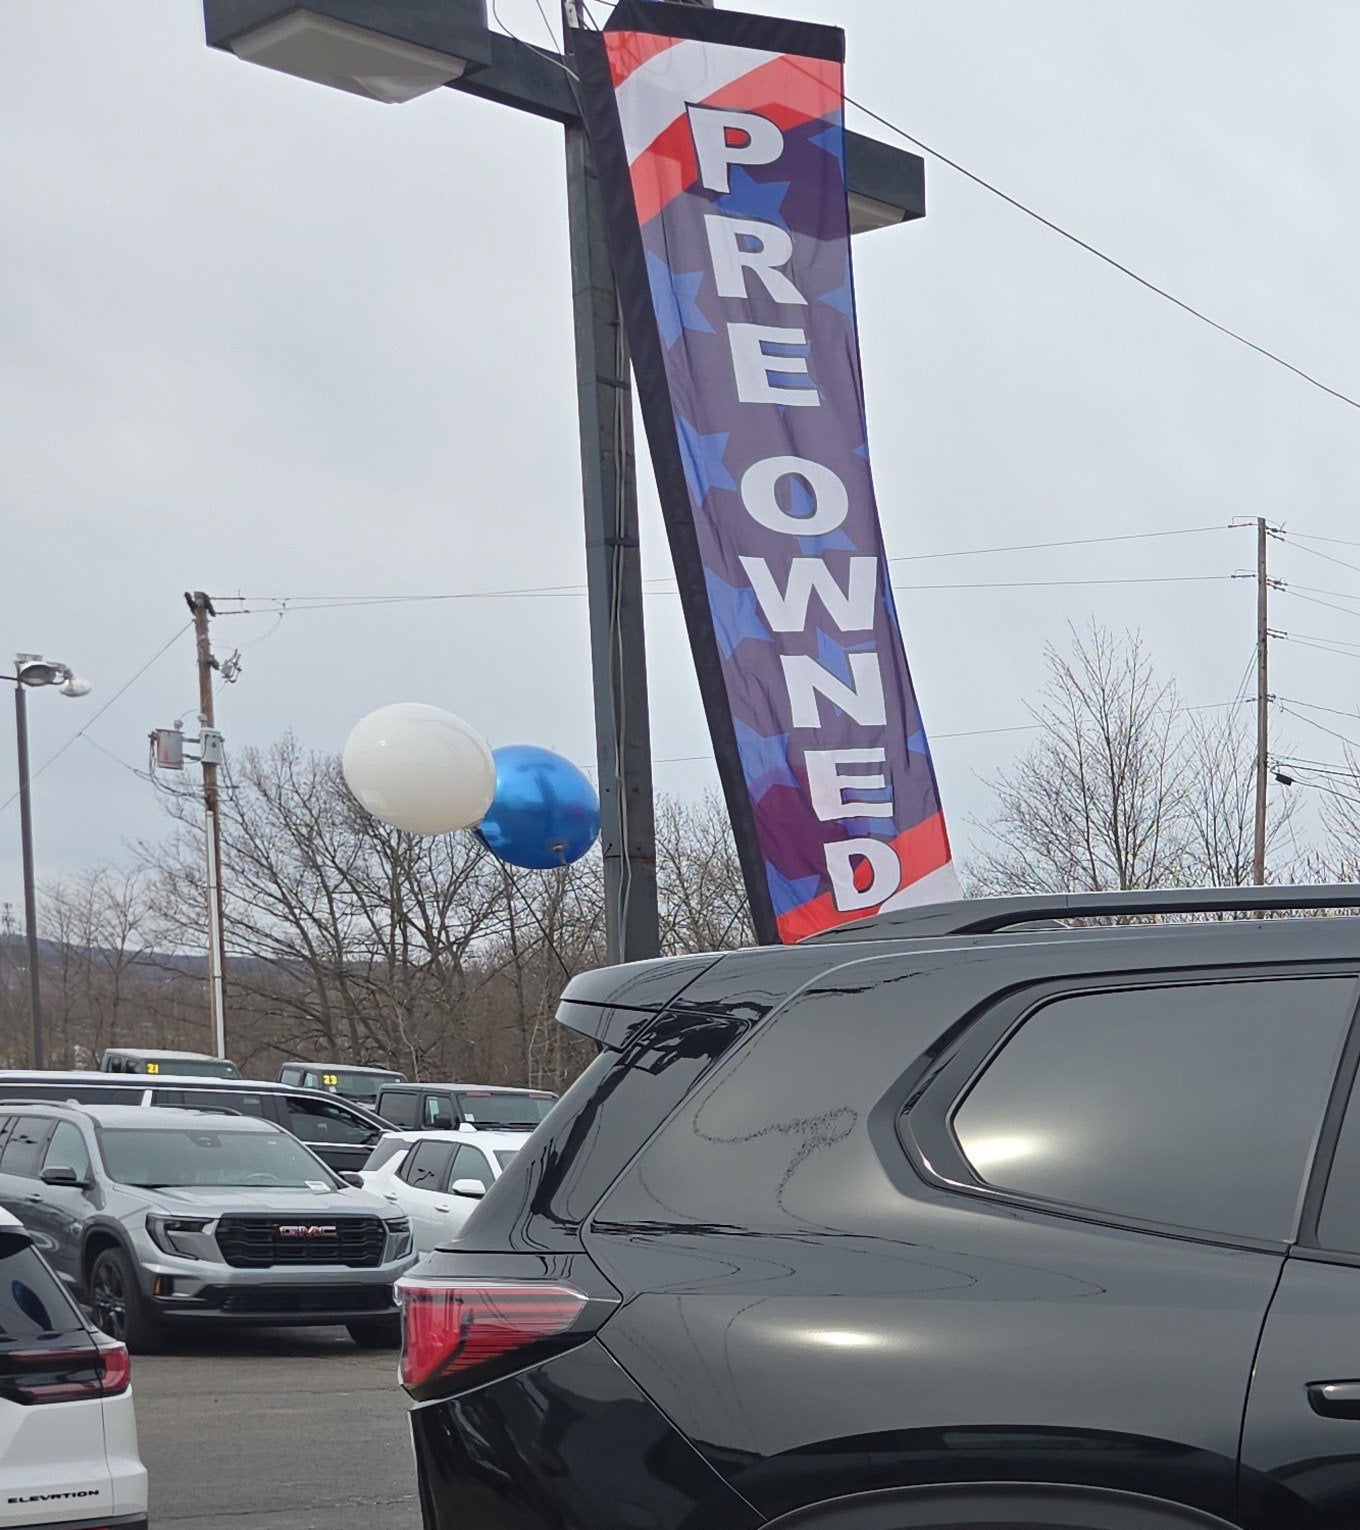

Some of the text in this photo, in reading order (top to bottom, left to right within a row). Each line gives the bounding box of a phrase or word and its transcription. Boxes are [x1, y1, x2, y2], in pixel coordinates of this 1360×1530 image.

[684, 101, 902, 913] PRE OWNED
[279, 1225, 338, 1238] GMC
[7, 1489, 100, 1505] ELEVATION
